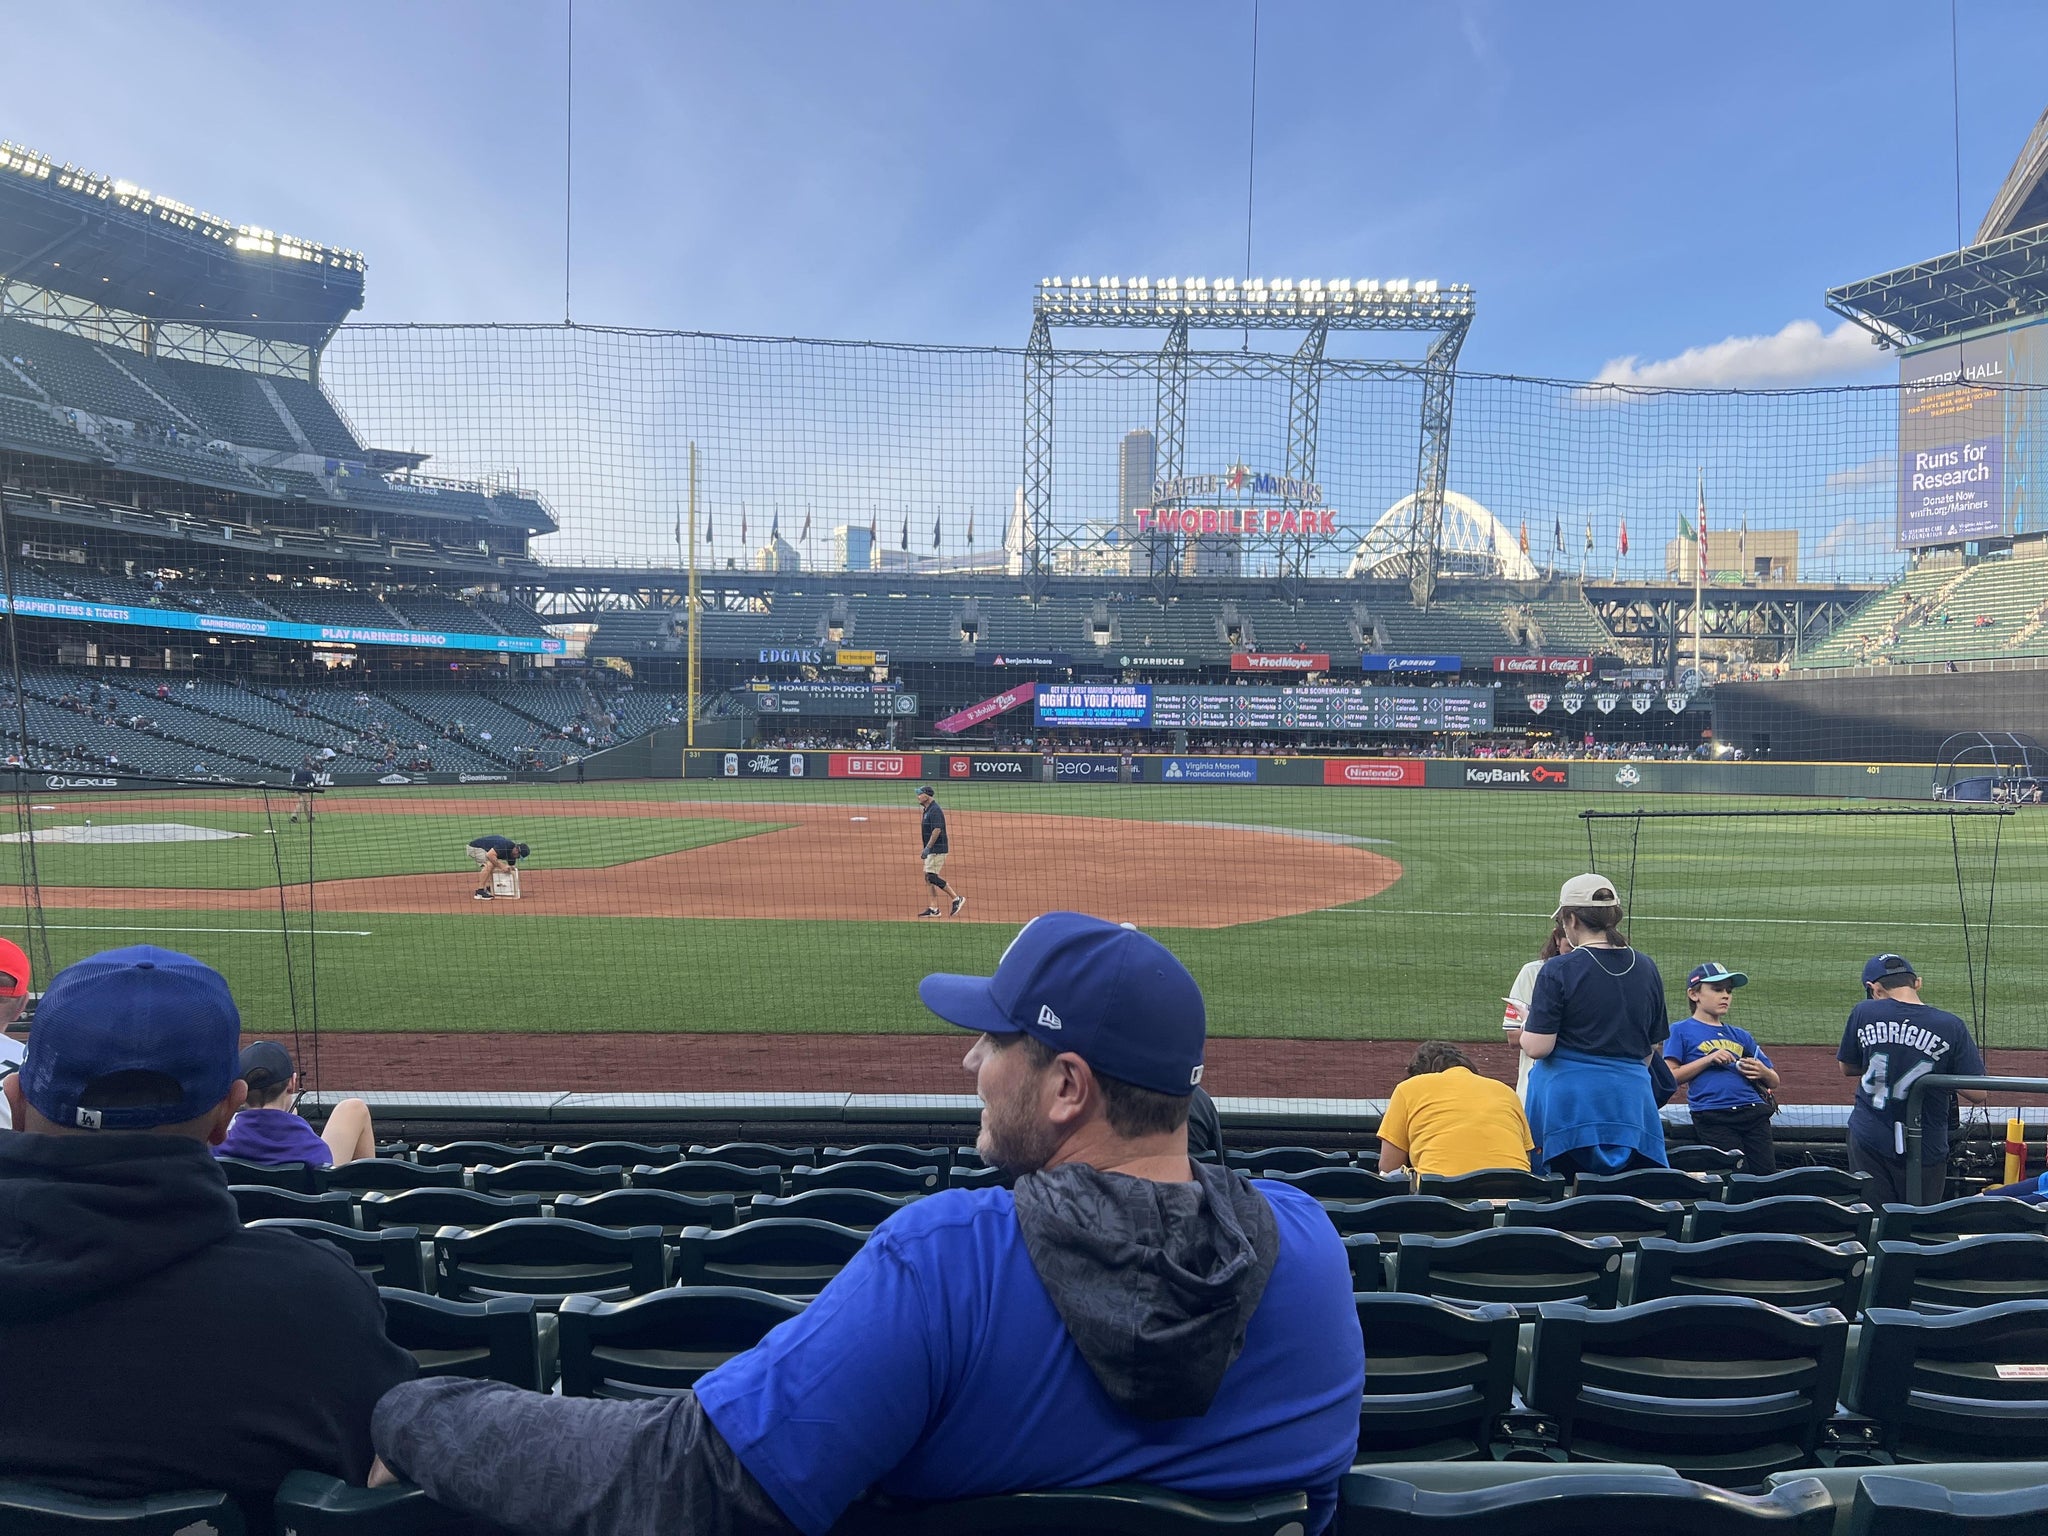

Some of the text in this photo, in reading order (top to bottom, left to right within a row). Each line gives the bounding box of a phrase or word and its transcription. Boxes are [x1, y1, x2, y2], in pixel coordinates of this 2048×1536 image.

[1966, 360, 2003, 380] HALL
[1916, 444, 1987, 471] Runs for
[1912, 462, 1989, 491] Research
[388, 482, 439, 496] Trident Deck
[1152, 472, 1322, 503] SEATTLE MARINERS
[1922, 491, 1976, 506] Donate Now
[1910, 500, 1988, 518] vmfh.org/Mariners
[1134, 508, 1338, 535] T-MOBILE PARK
[58, 605, 129, 620] ITEMS & TICKETS
[322, 628, 446, 645] PLAY MARINERS BINGO
[875, 654, 888, 662] CAT
[1005, 658, 1032, 666] Benjamin
[1132, 658, 1185, 666] STARBUCKS
[1051, 686, 1060, 694] GET
[1060, 686, 1070, 694] THE
[1070, 686, 1086, 694] LATEST
[1040, 694, 1146, 708] RIGHT TO YOUR PHONE!
[1203, 696, 1228, 704] Washington
[1532, 701, 1544, 709] 42
[1566, 701, 1578, 709] 24
[1602, 701, 1611, 709] 11
[1636, 700, 1646, 709] 51
[1672, 700, 1682, 709] 51
[1136, 710, 1144, 718] UP
[1172, 712, 1180, 720] Bay
[748, 758, 780, 772] Miller
[974, 762, 1022, 772] TOYOTA
[1056, 762, 1092, 774] eero
[1186, 762, 1240, 770] Virginia Mason
[1866, 766, 1880, 774] 401
[1186, 770, 1252, 778] Franciscan Health
[1350, 768, 1400, 778] Nintendo
[1466, 768, 1530, 784] KeyBank
[1621, 769, 1636, 779] 50
[66, 778, 118, 787] LEXUS
[1857, 1018, 1950, 1062] RODRÍGUEZ
[80, 1110, 95, 1126] LA
